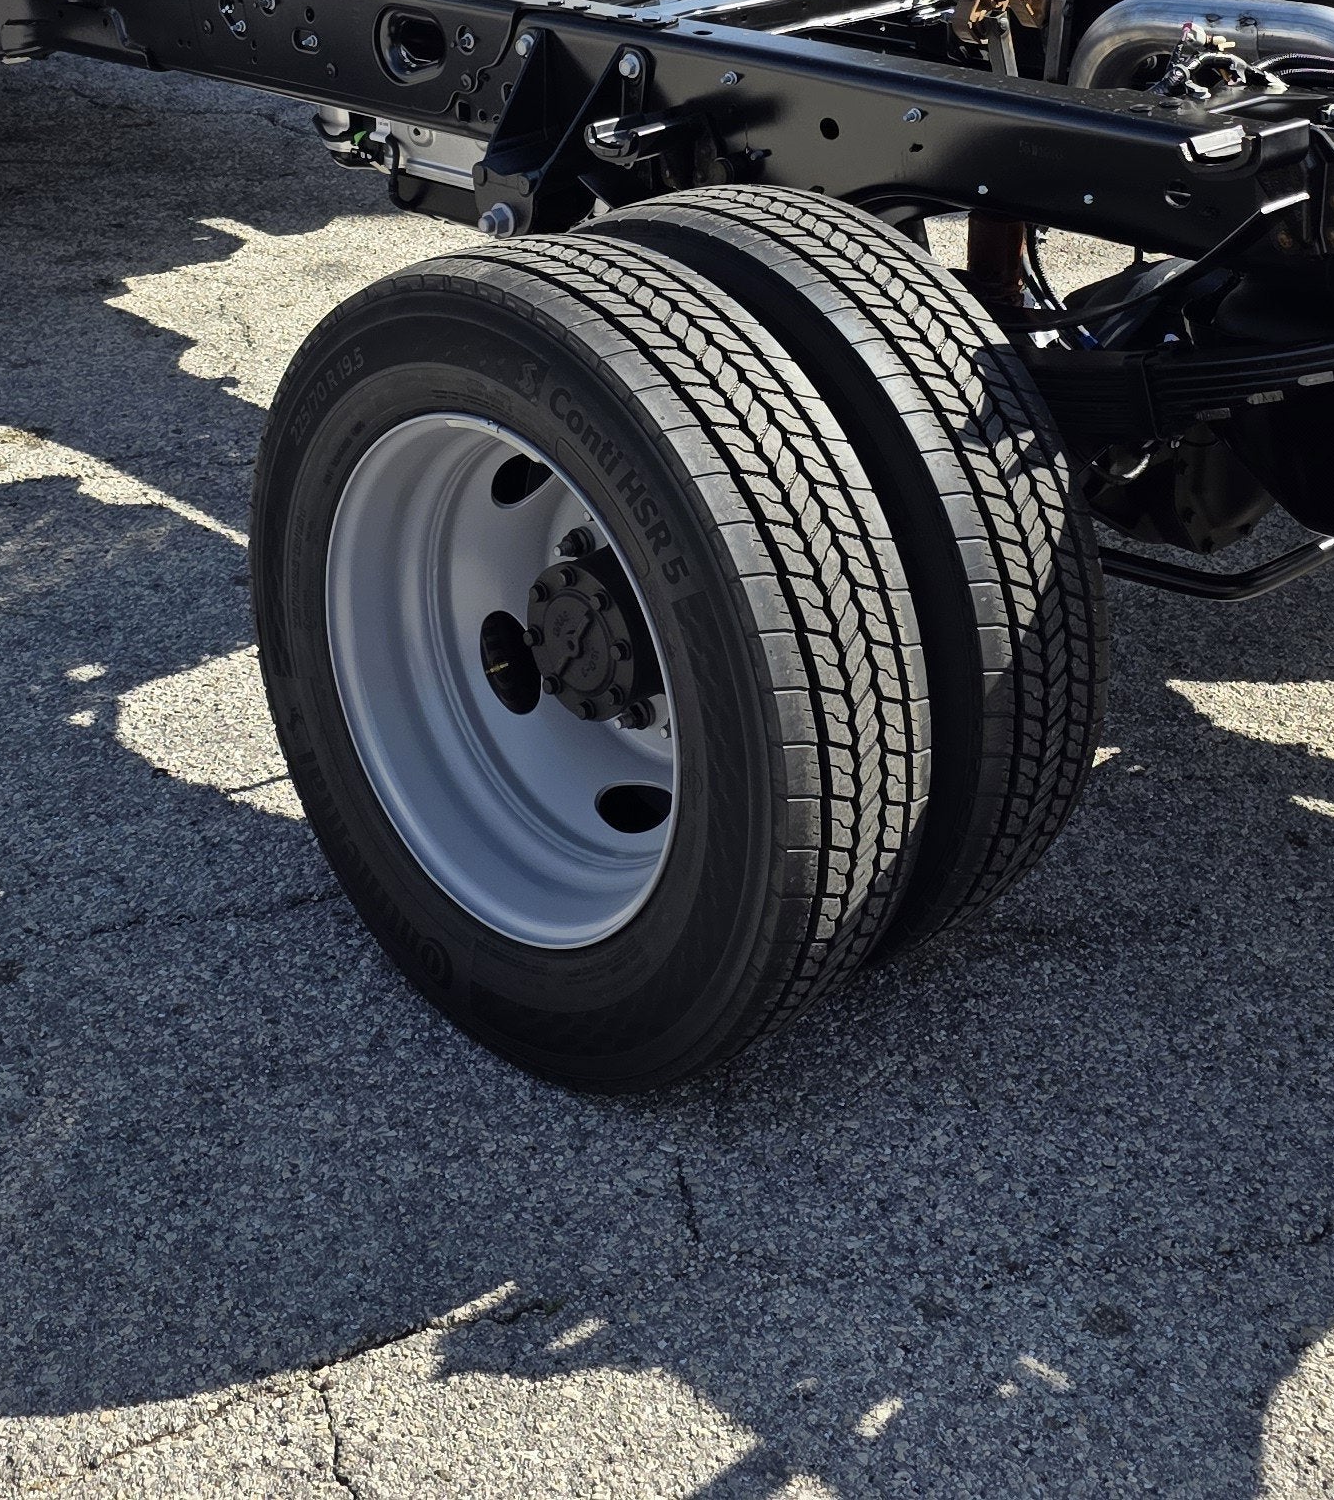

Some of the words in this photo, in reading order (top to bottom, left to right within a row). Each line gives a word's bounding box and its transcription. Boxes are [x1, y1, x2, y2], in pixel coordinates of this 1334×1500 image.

[549, 387, 624, 477] Conti
[616, 468, 673, 557] HSR
[661, 555, 691, 586] 5
